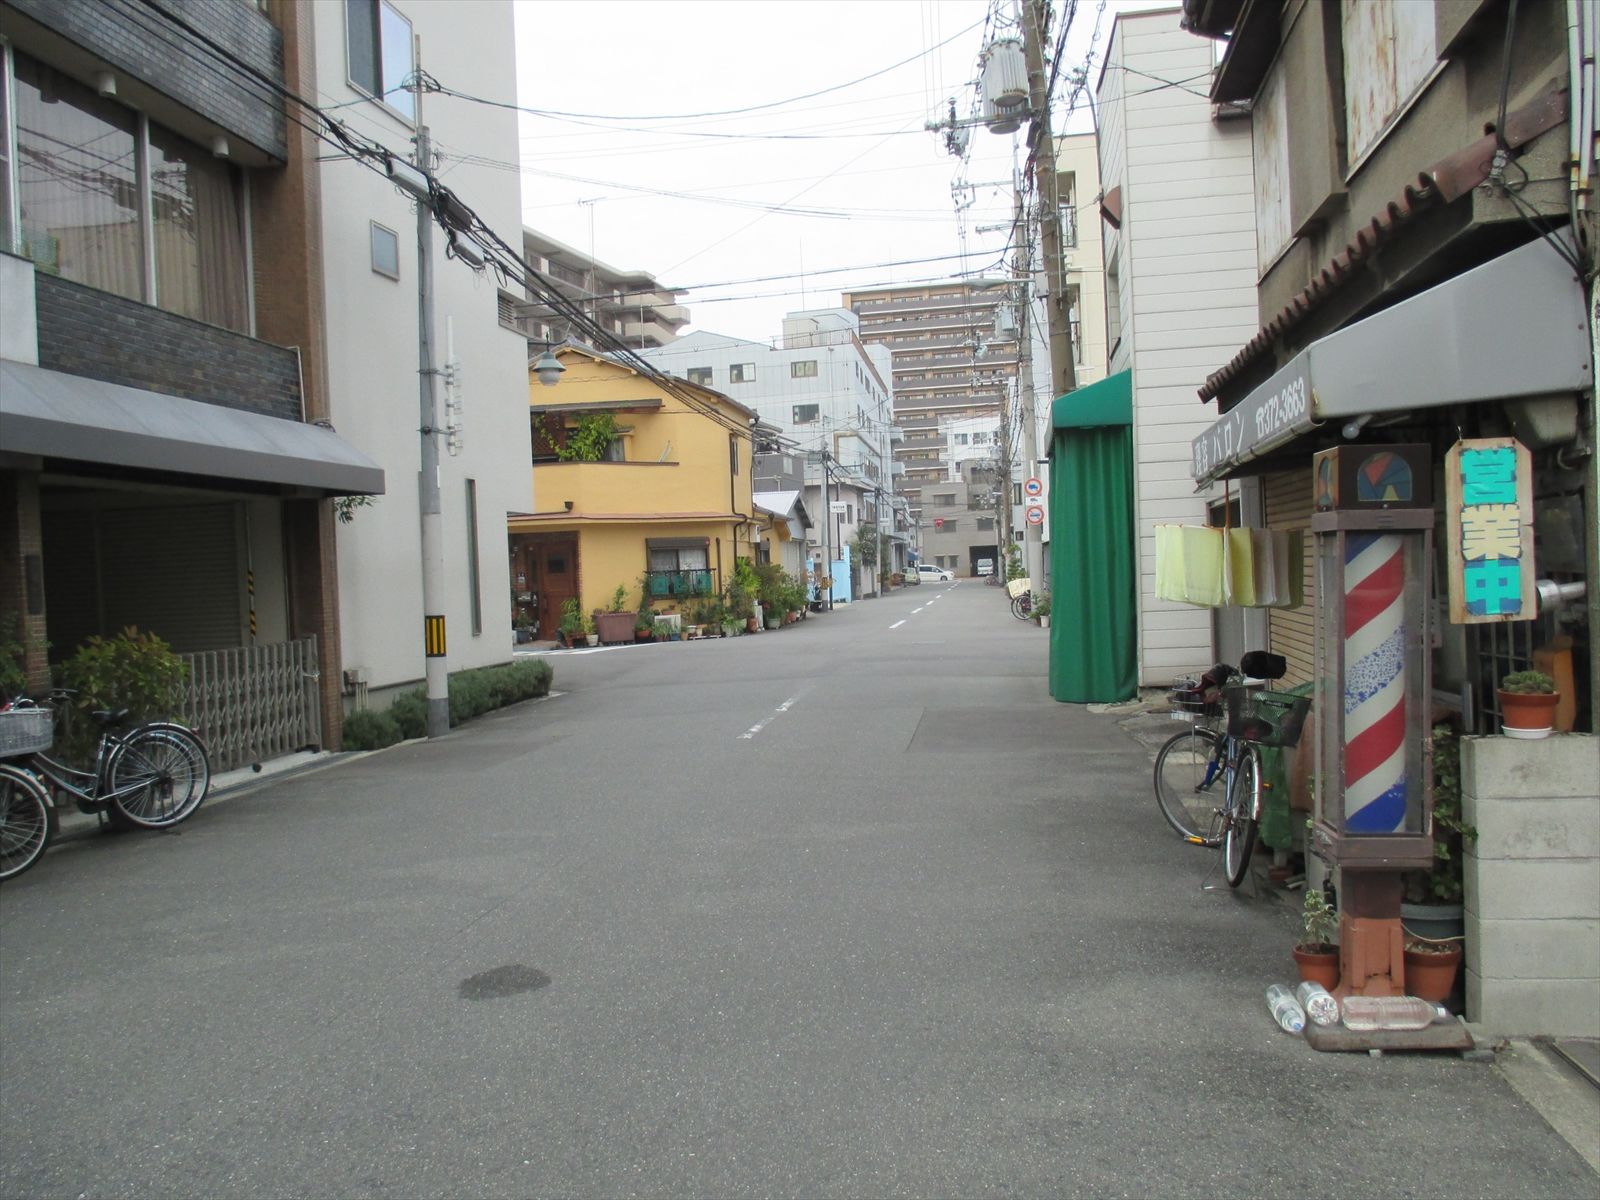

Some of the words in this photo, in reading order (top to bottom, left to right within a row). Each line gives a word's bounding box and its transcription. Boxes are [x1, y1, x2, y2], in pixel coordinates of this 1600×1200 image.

[1213, 411, 1245, 463] バロン
[1459, 446, 1522, 616] 営業中
